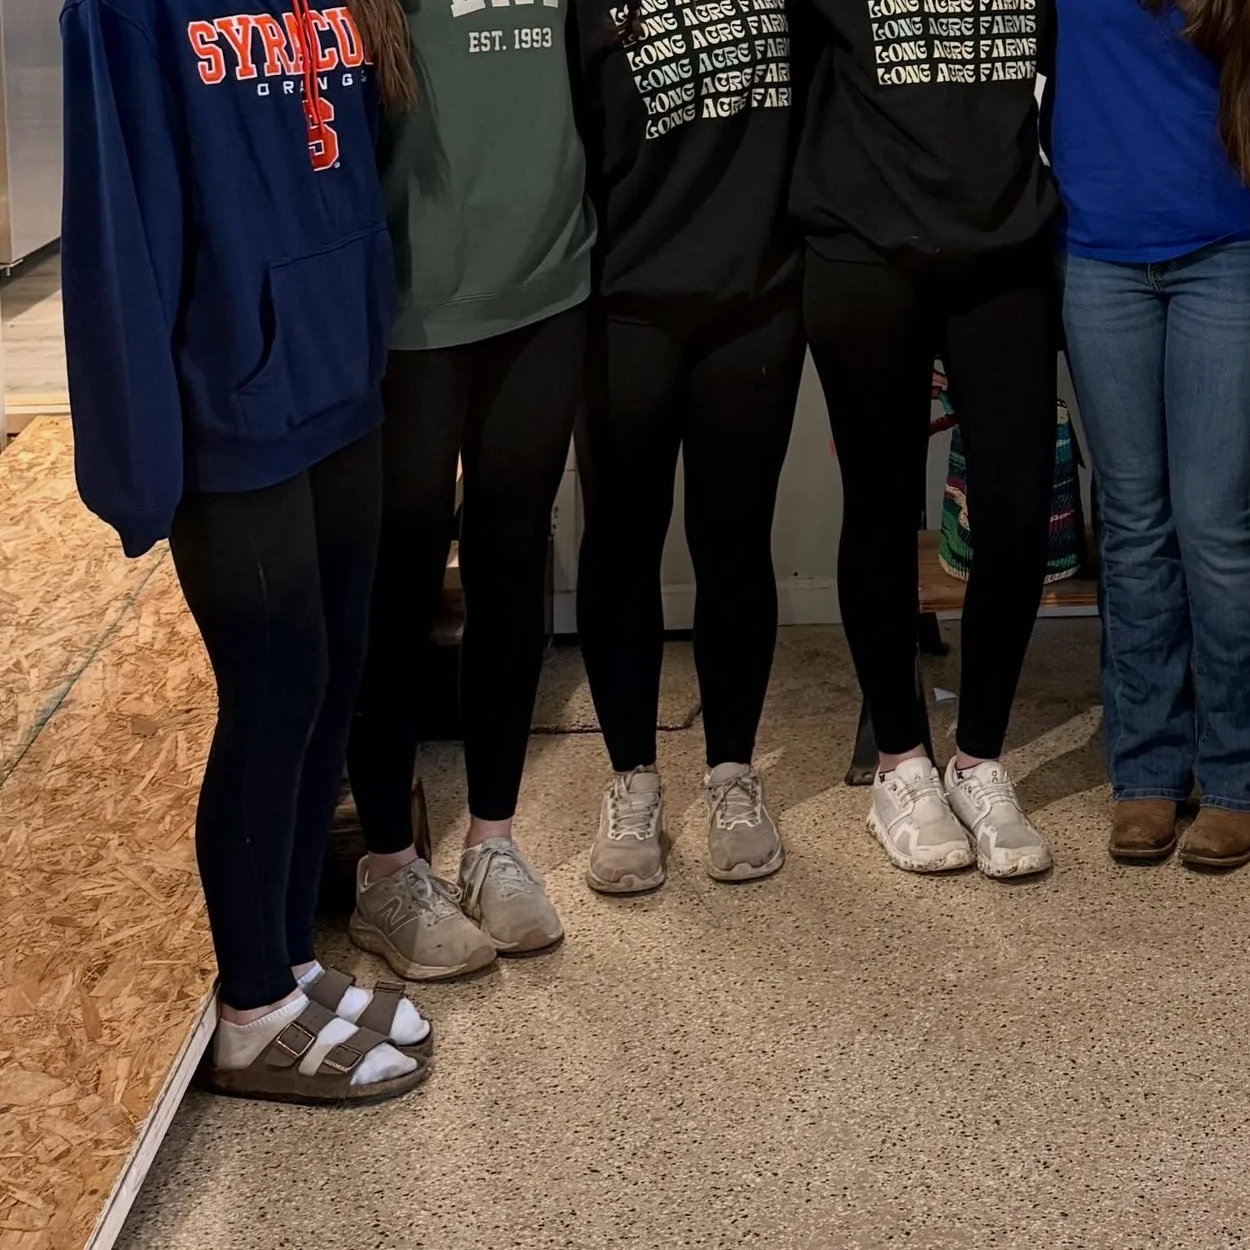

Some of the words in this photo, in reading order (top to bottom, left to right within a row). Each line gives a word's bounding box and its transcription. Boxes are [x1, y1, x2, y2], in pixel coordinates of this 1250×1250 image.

[682, 0, 736, 27] ACRE
[872, 16, 923, 42] LONG
[928, 17, 975, 37] ACRE
[979, 15, 1037, 35] FARMS
[188, 7, 370, 85] SYRACU
[469, 30, 507, 53] EST.
[514, 27, 552, 50] 1993
[626, 34, 687, 71] LONG
[691, 19, 746, 49] ACRE
[875, 40, 928, 64] LONG
[979, 37, 1037, 59] FARMS
[634, 58, 693, 94] LONG
[699, 42, 752, 74] ACRE
[877, 63, 931, 86] LONG
[642, 82, 695, 115] LONG
[700, 67, 753, 96] ACRE
[645, 103, 696, 140] LONG
